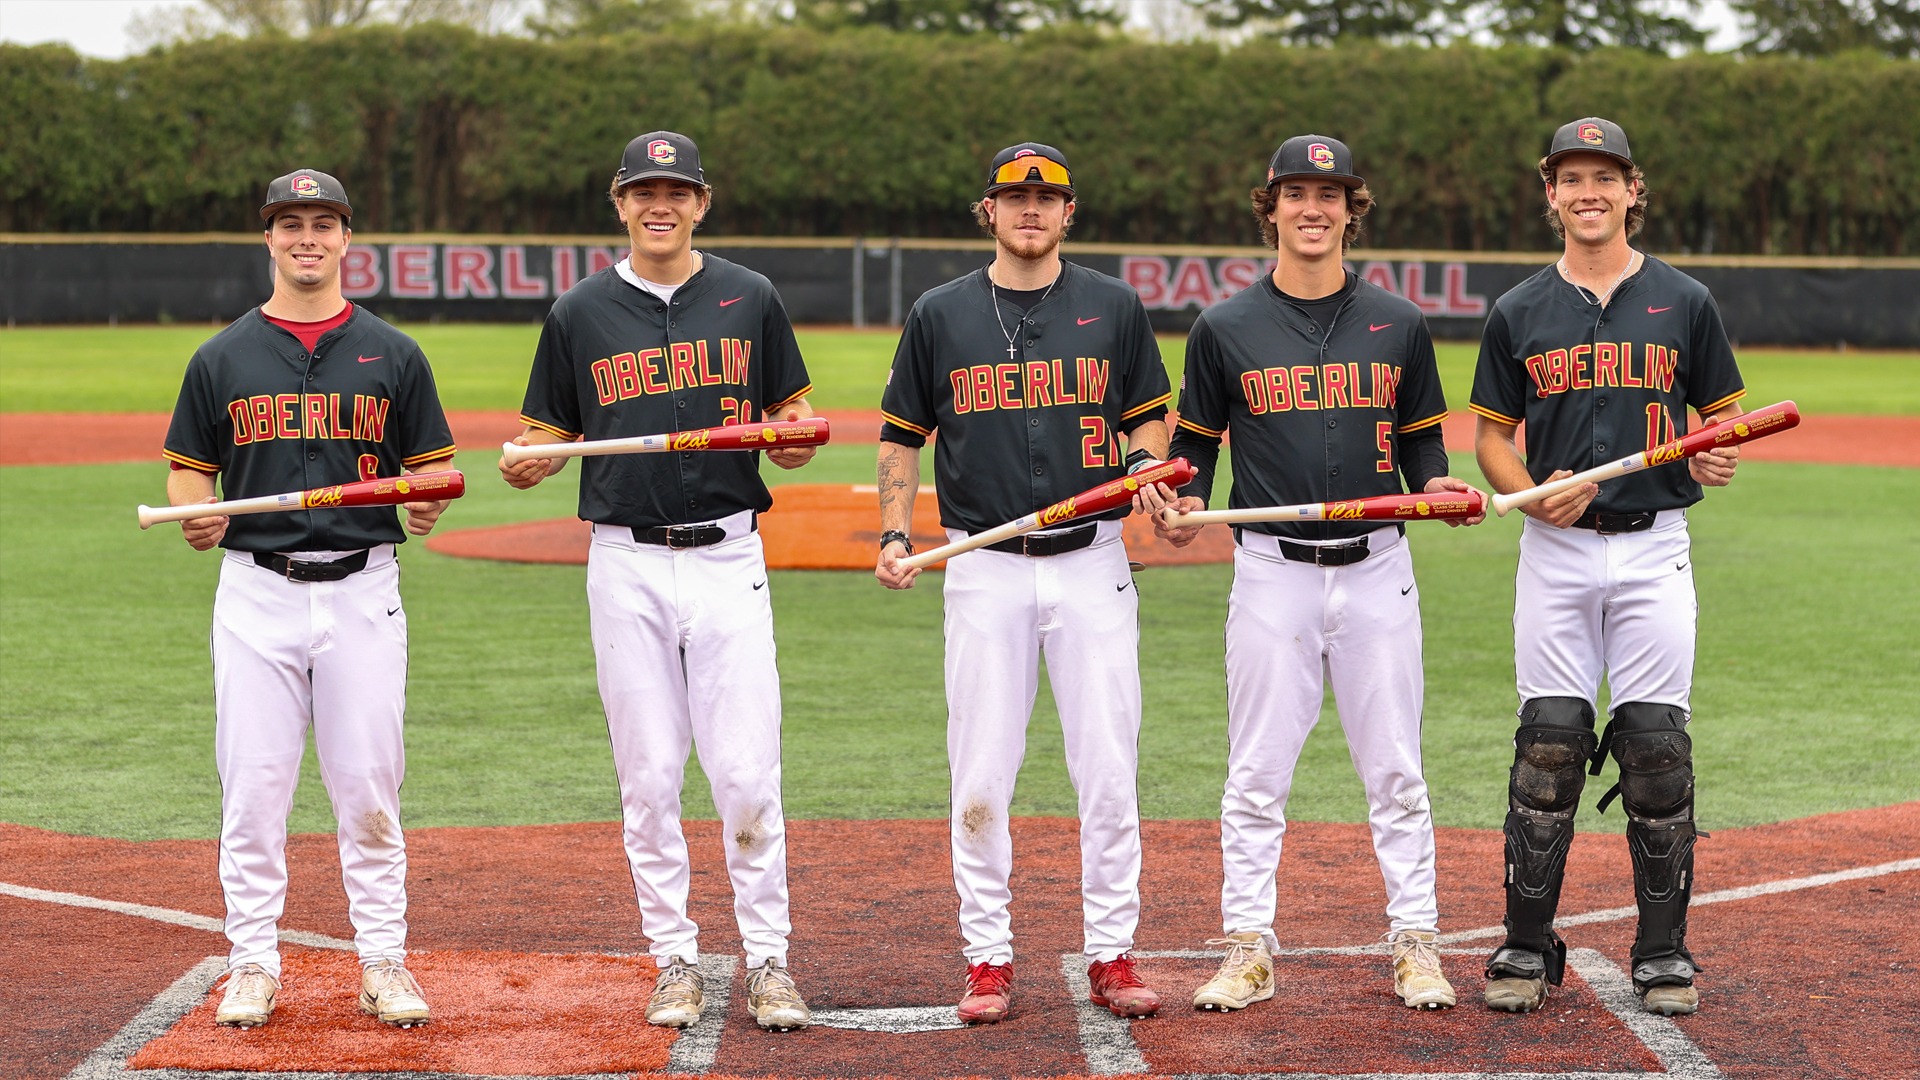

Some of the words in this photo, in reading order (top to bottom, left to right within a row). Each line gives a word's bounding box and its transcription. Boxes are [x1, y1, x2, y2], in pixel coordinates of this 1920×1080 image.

[591, 338, 751, 407] OBERLIN
[950, 357, 1109, 415] OBERLIN
[1240, 362, 1402, 416] OBERLIN
[1525, 342, 1678, 398] OBERLIN
[228, 393, 390, 446] OBERLIN
[674, 429, 710, 450] Cal
[1376, 421, 1394, 473] 5
[1651, 440, 1685, 466] Cal
[307, 485, 343, 507] Cal
[1044, 496, 1076, 523] Cal
[1329, 502, 1365, 520] Cal
